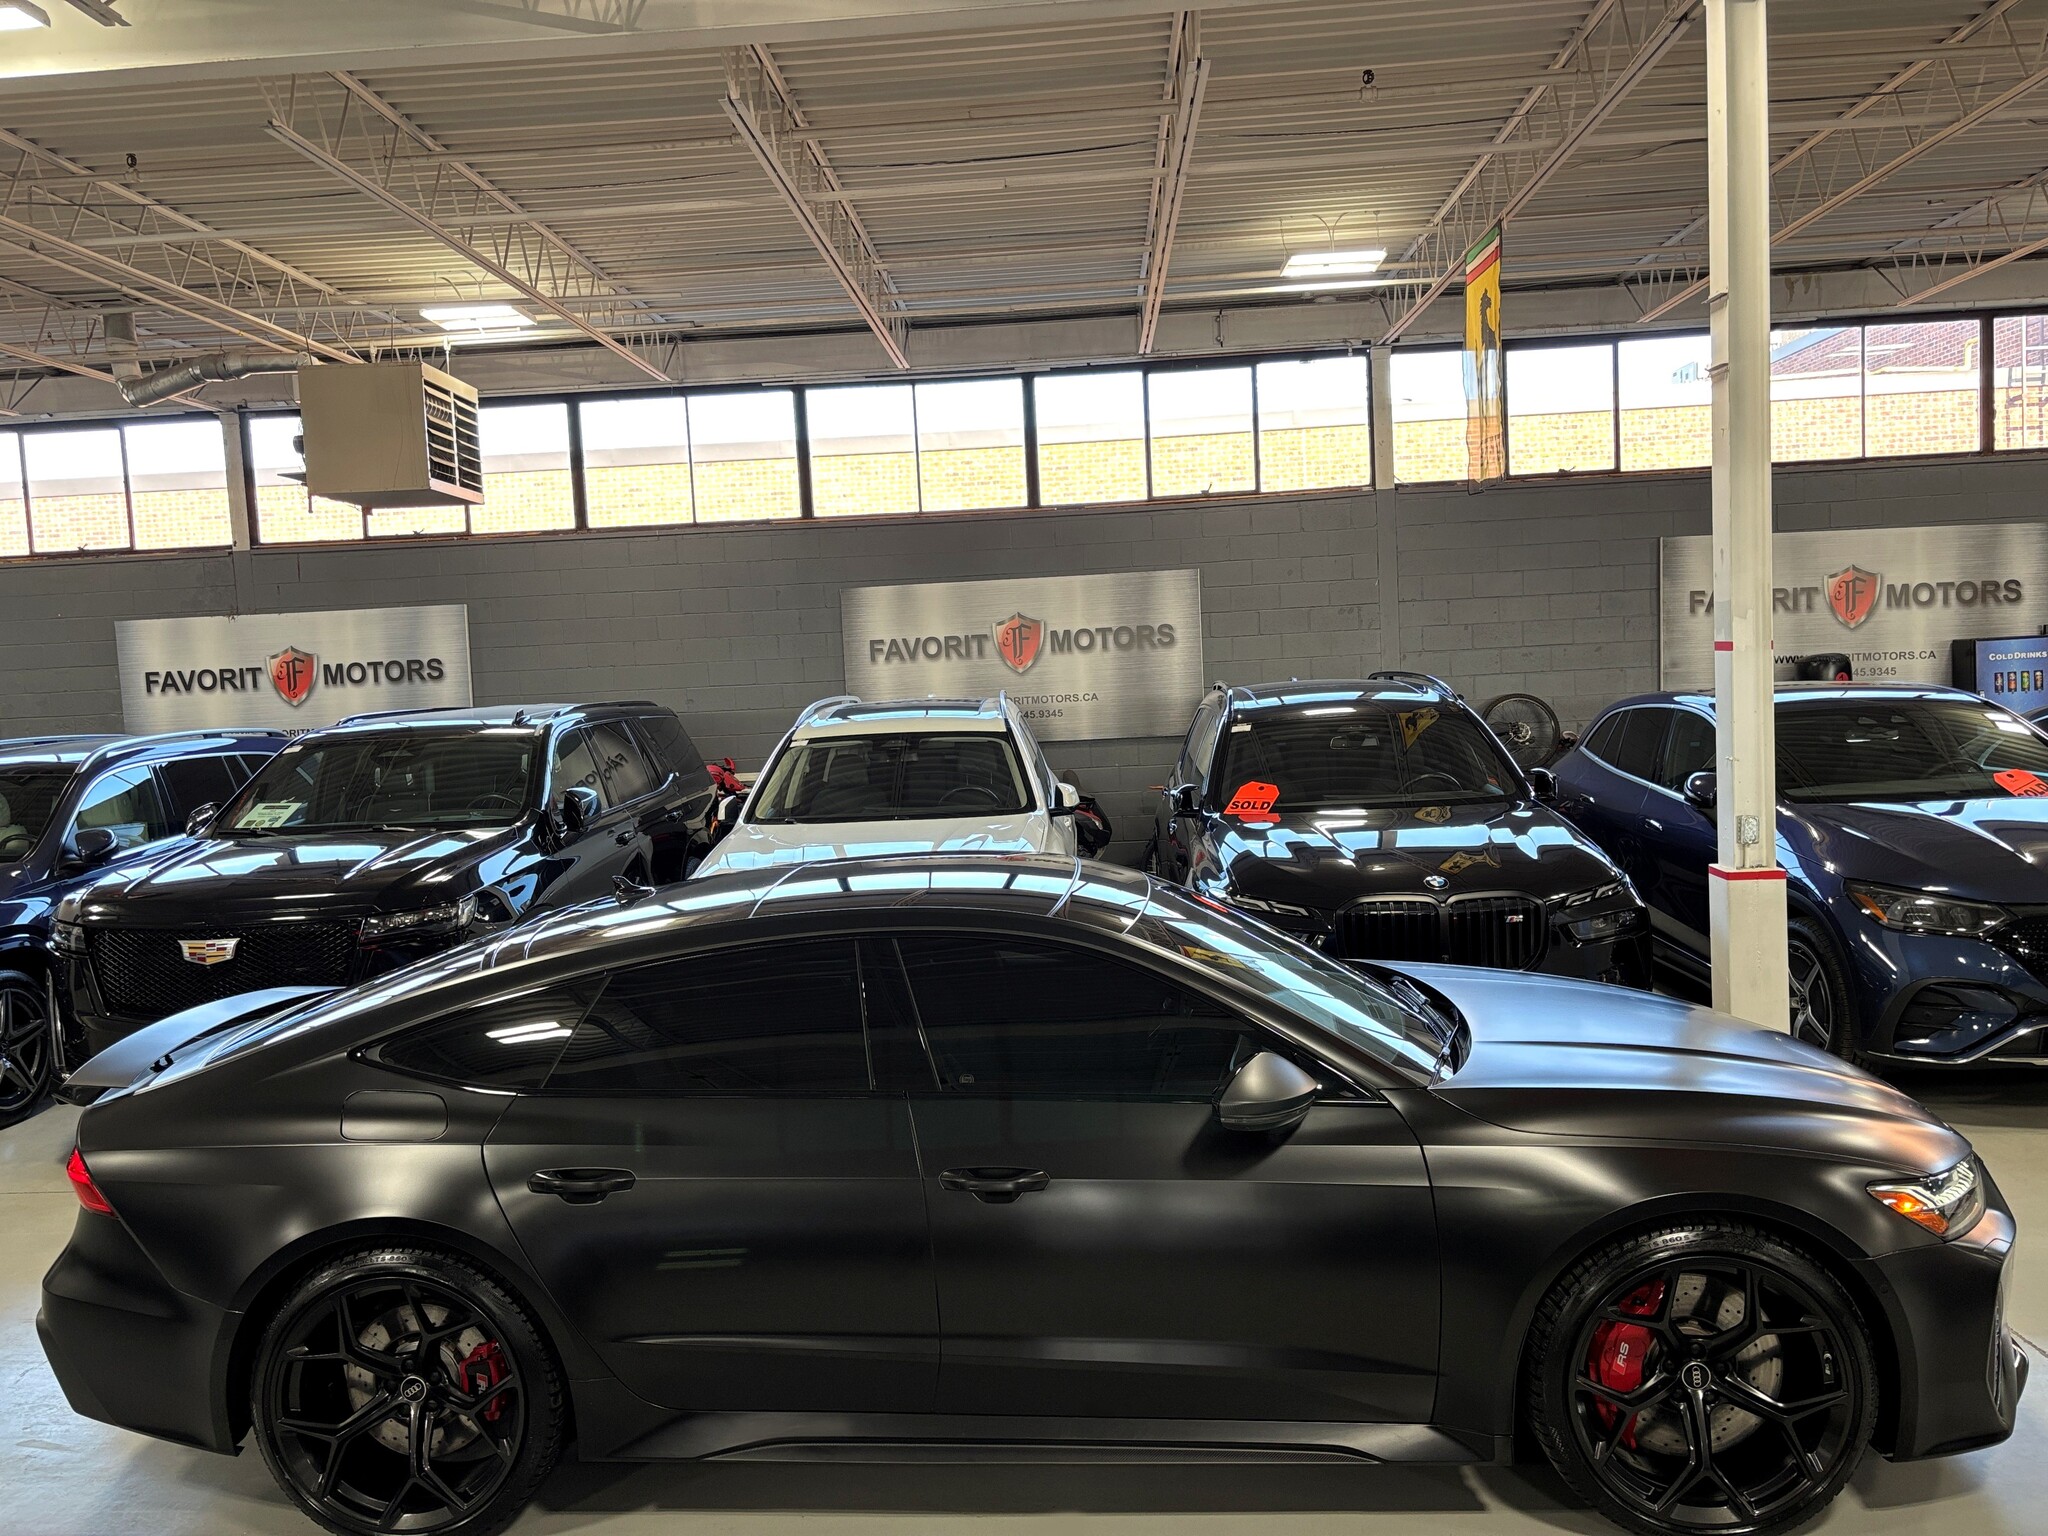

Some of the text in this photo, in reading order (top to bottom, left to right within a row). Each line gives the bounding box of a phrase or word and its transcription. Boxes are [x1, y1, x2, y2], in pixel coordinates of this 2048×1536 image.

[1690, 579, 2023, 613] FRIT MOTORS
[869, 623, 1176, 662] FAVORIT MOTORS
[145, 658, 445, 693] FAVORIT MOTORS
[1230, 801, 1271, 810] SOLD
[1617, 1341, 1629, 1368] RS
